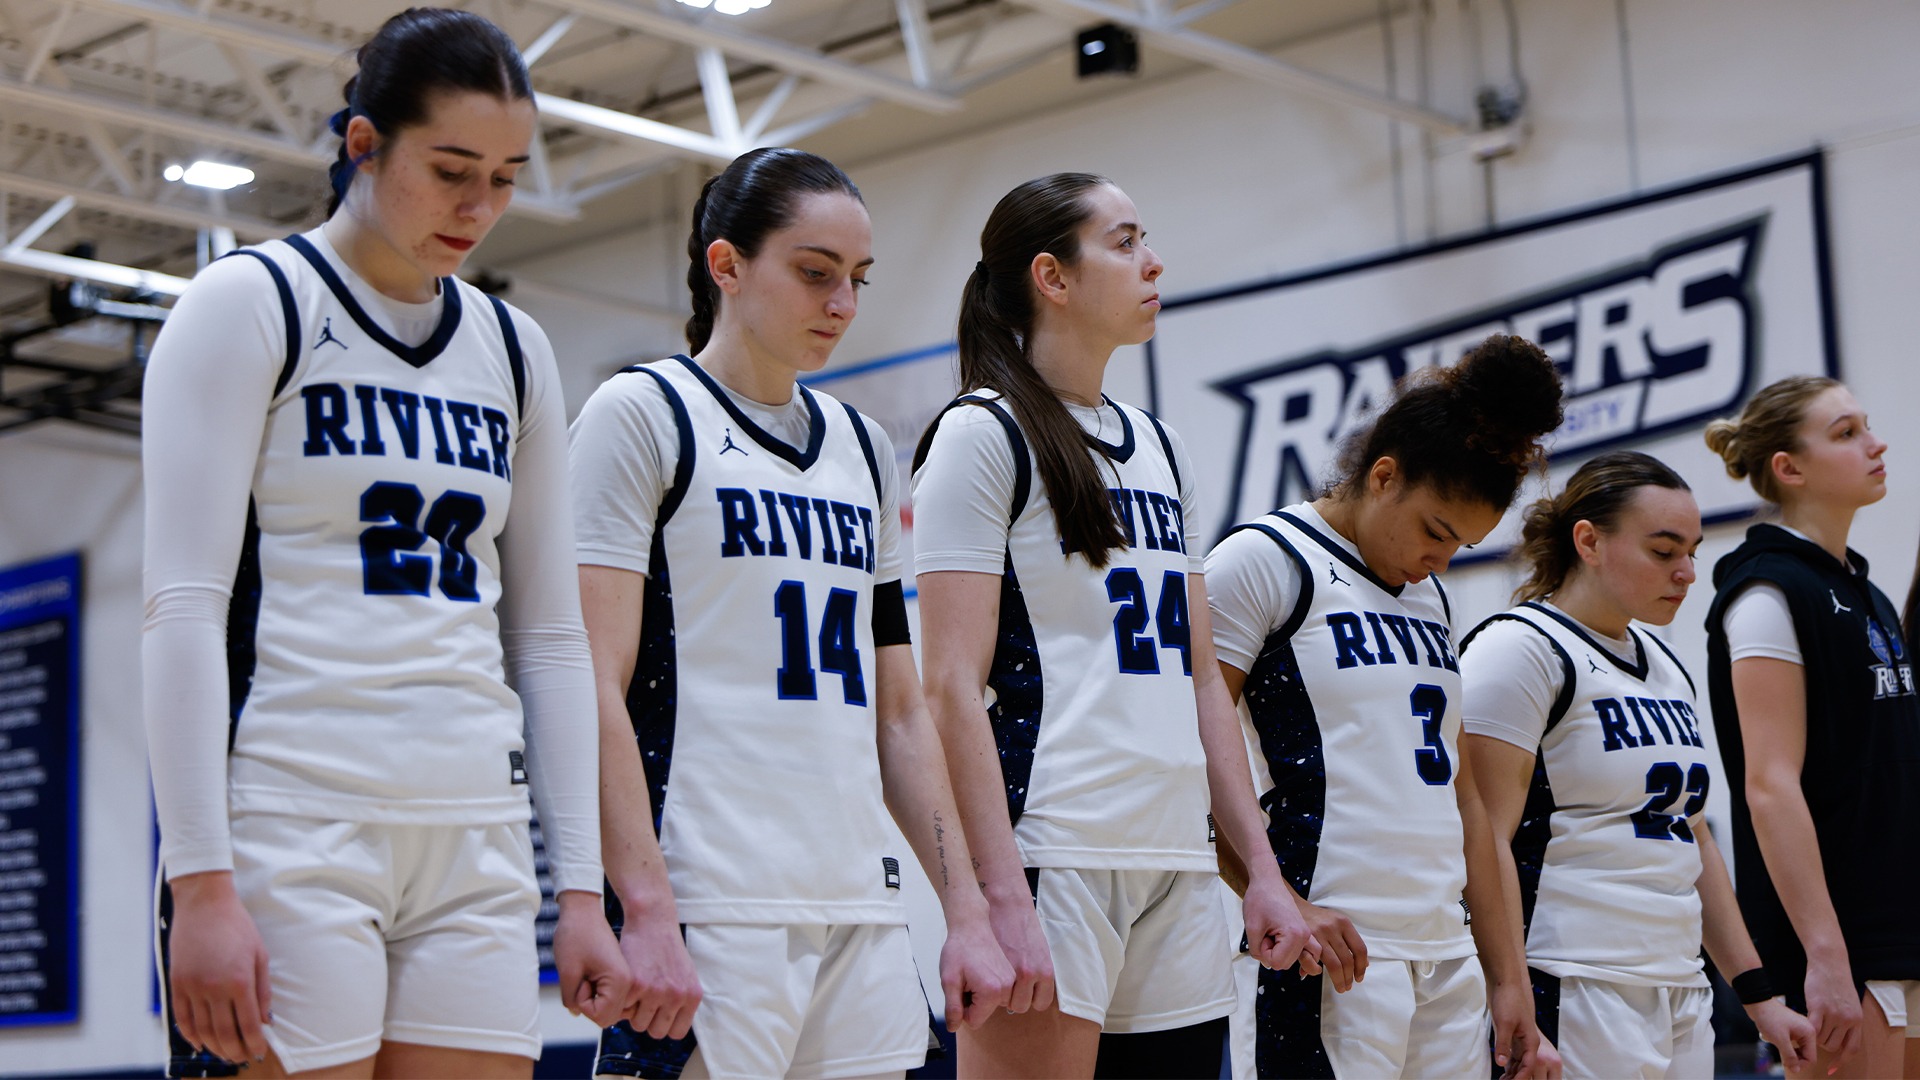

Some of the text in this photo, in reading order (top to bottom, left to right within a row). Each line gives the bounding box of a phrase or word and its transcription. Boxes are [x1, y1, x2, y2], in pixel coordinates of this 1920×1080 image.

[301, 382, 511, 483] RIVIER
[359, 480, 487, 602] 20
[1054, 487, 1187, 556] VIER
[774, 579, 867, 708] 14
[1104, 567, 1192, 676] 24
[1326, 611, 1461, 678] RIVIE
[1409, 673, 1452, 786] 3
[1592, 696, 1705, 752] RIVIE
